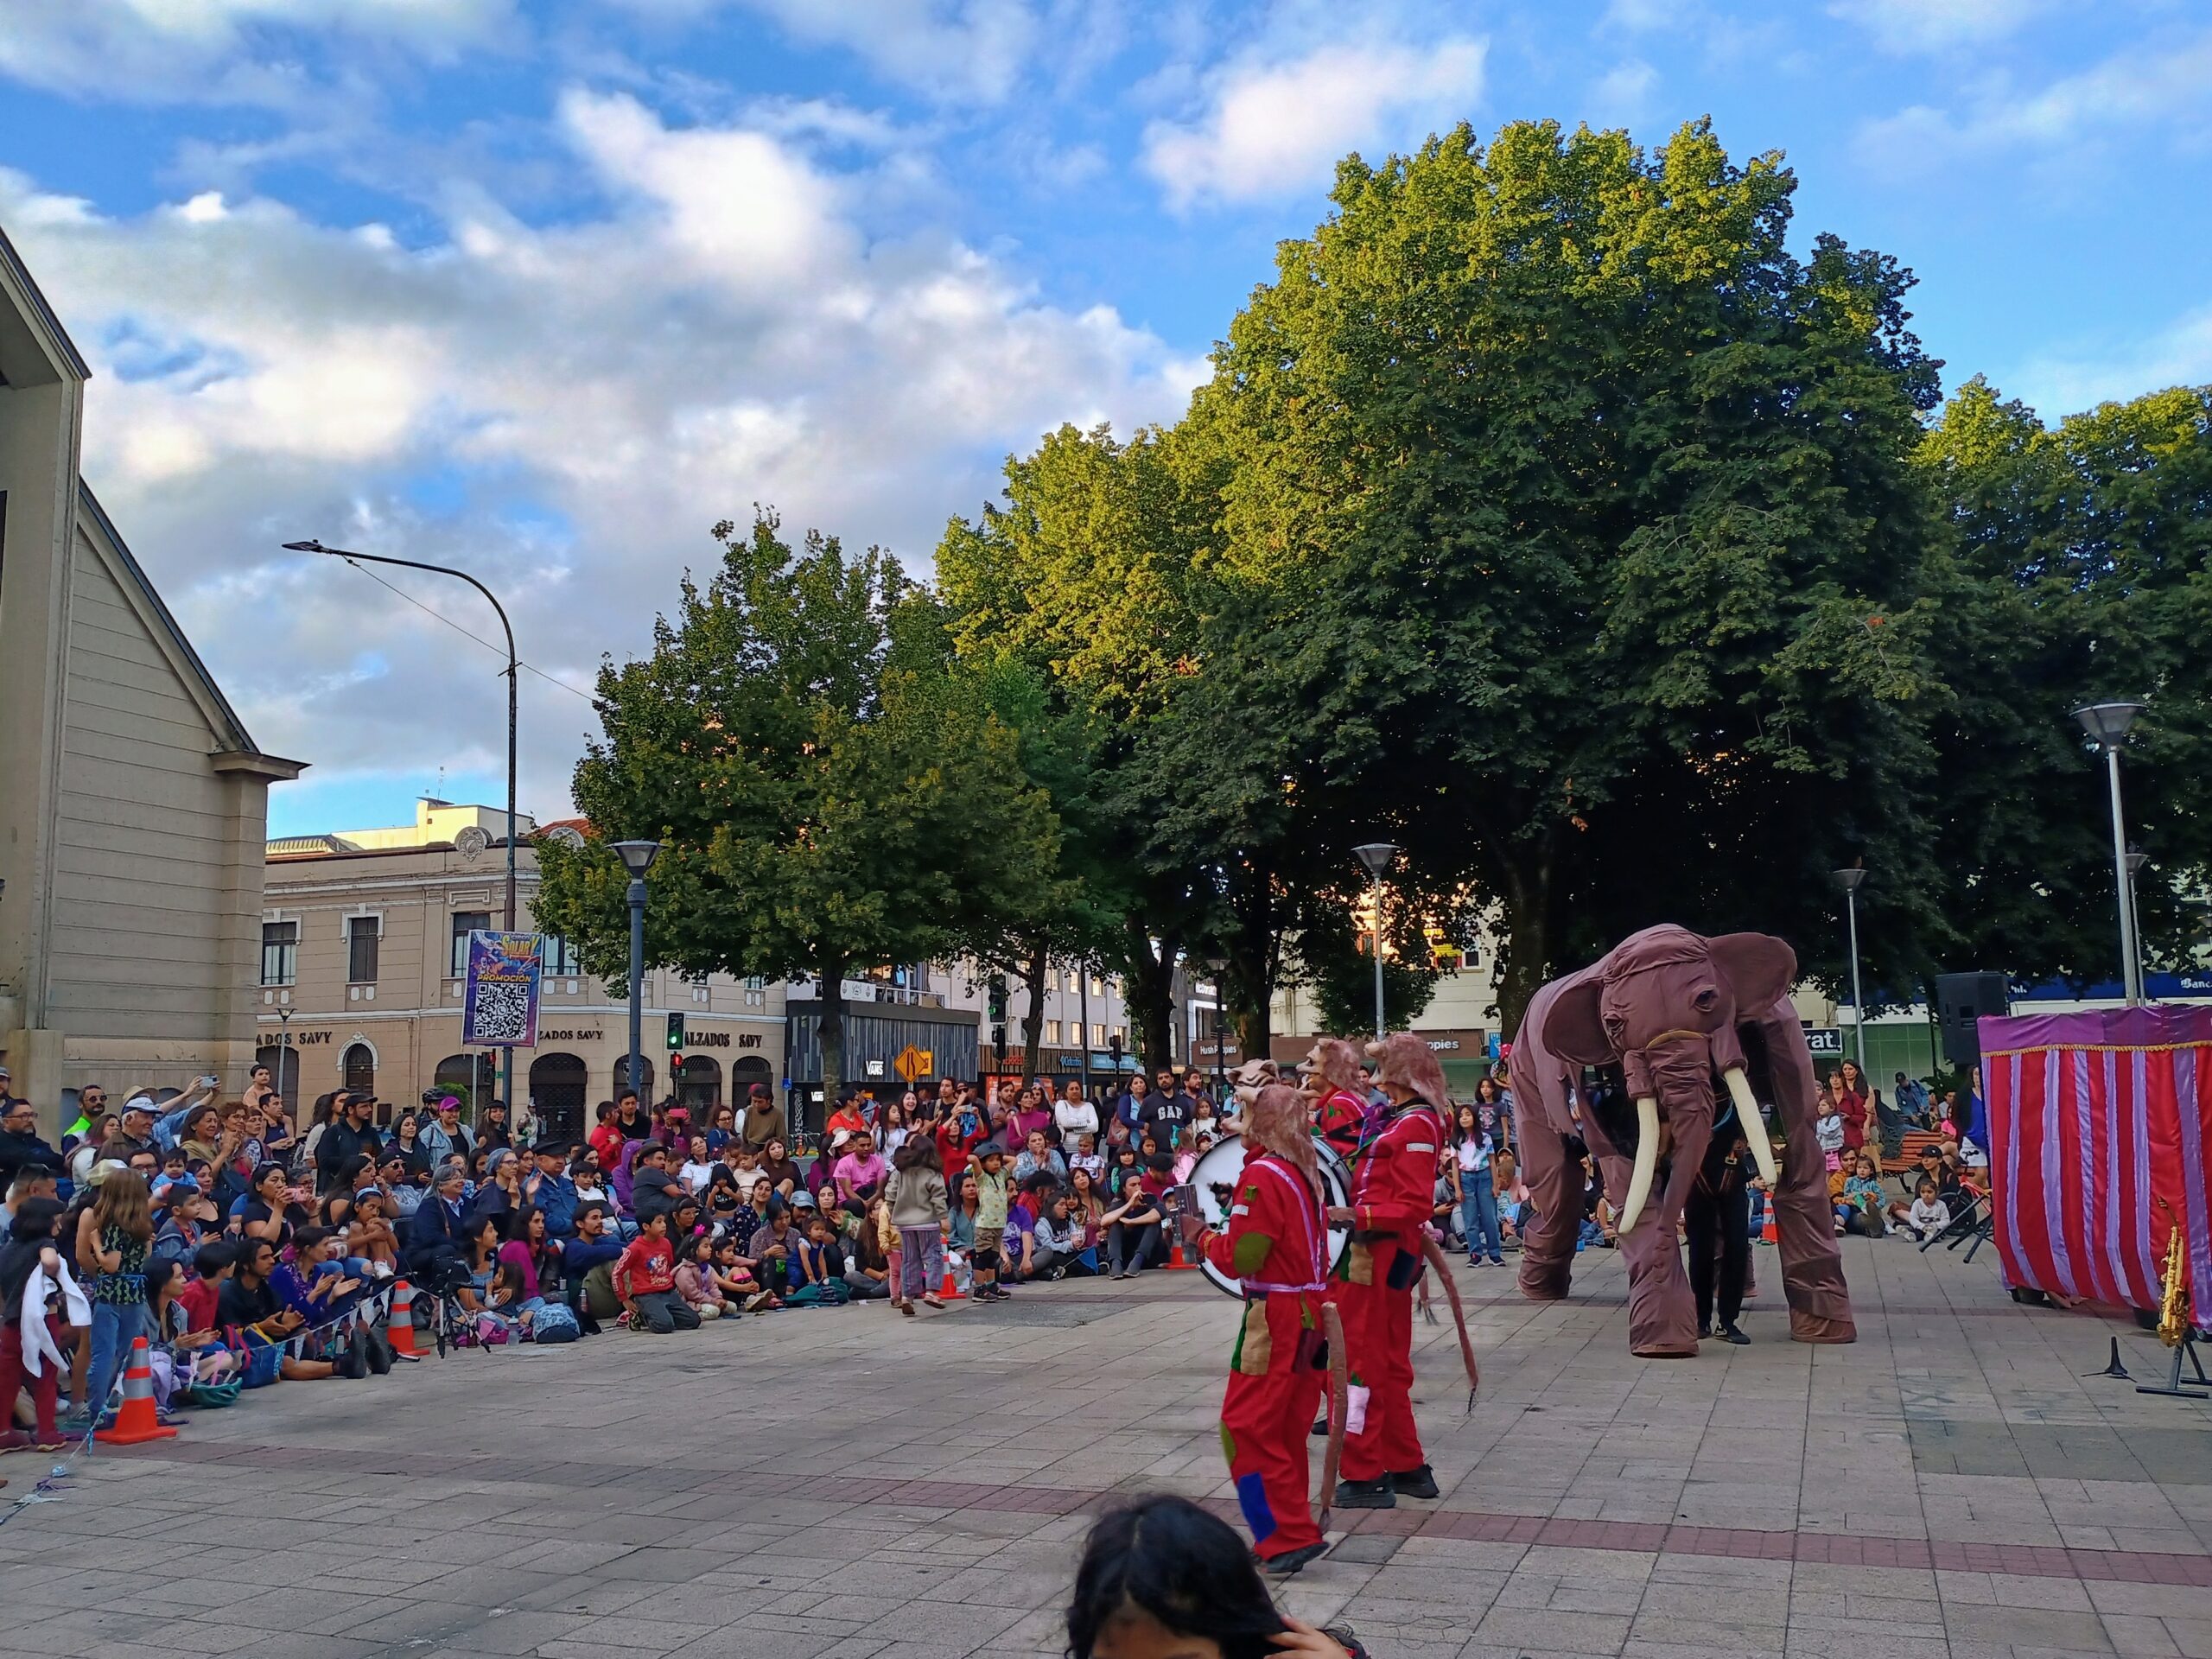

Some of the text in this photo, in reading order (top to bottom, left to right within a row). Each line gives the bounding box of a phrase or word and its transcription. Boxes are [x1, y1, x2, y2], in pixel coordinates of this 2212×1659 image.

[477, 973, 531, 982] PROMOCIÓN
[2180, 977, 2212, 988] Banc
[299, 1032, 333, 1045] SAVY
[576, 1030, 603, 1040] SAVY
[685, 1032, 762, 1048] ALZADOS SAVY
[1427, 1039, 1459, 1052] ppies
[866, 1060, 884, 1076] VANS
[1158, 1105, 1183, 1121] GAP
